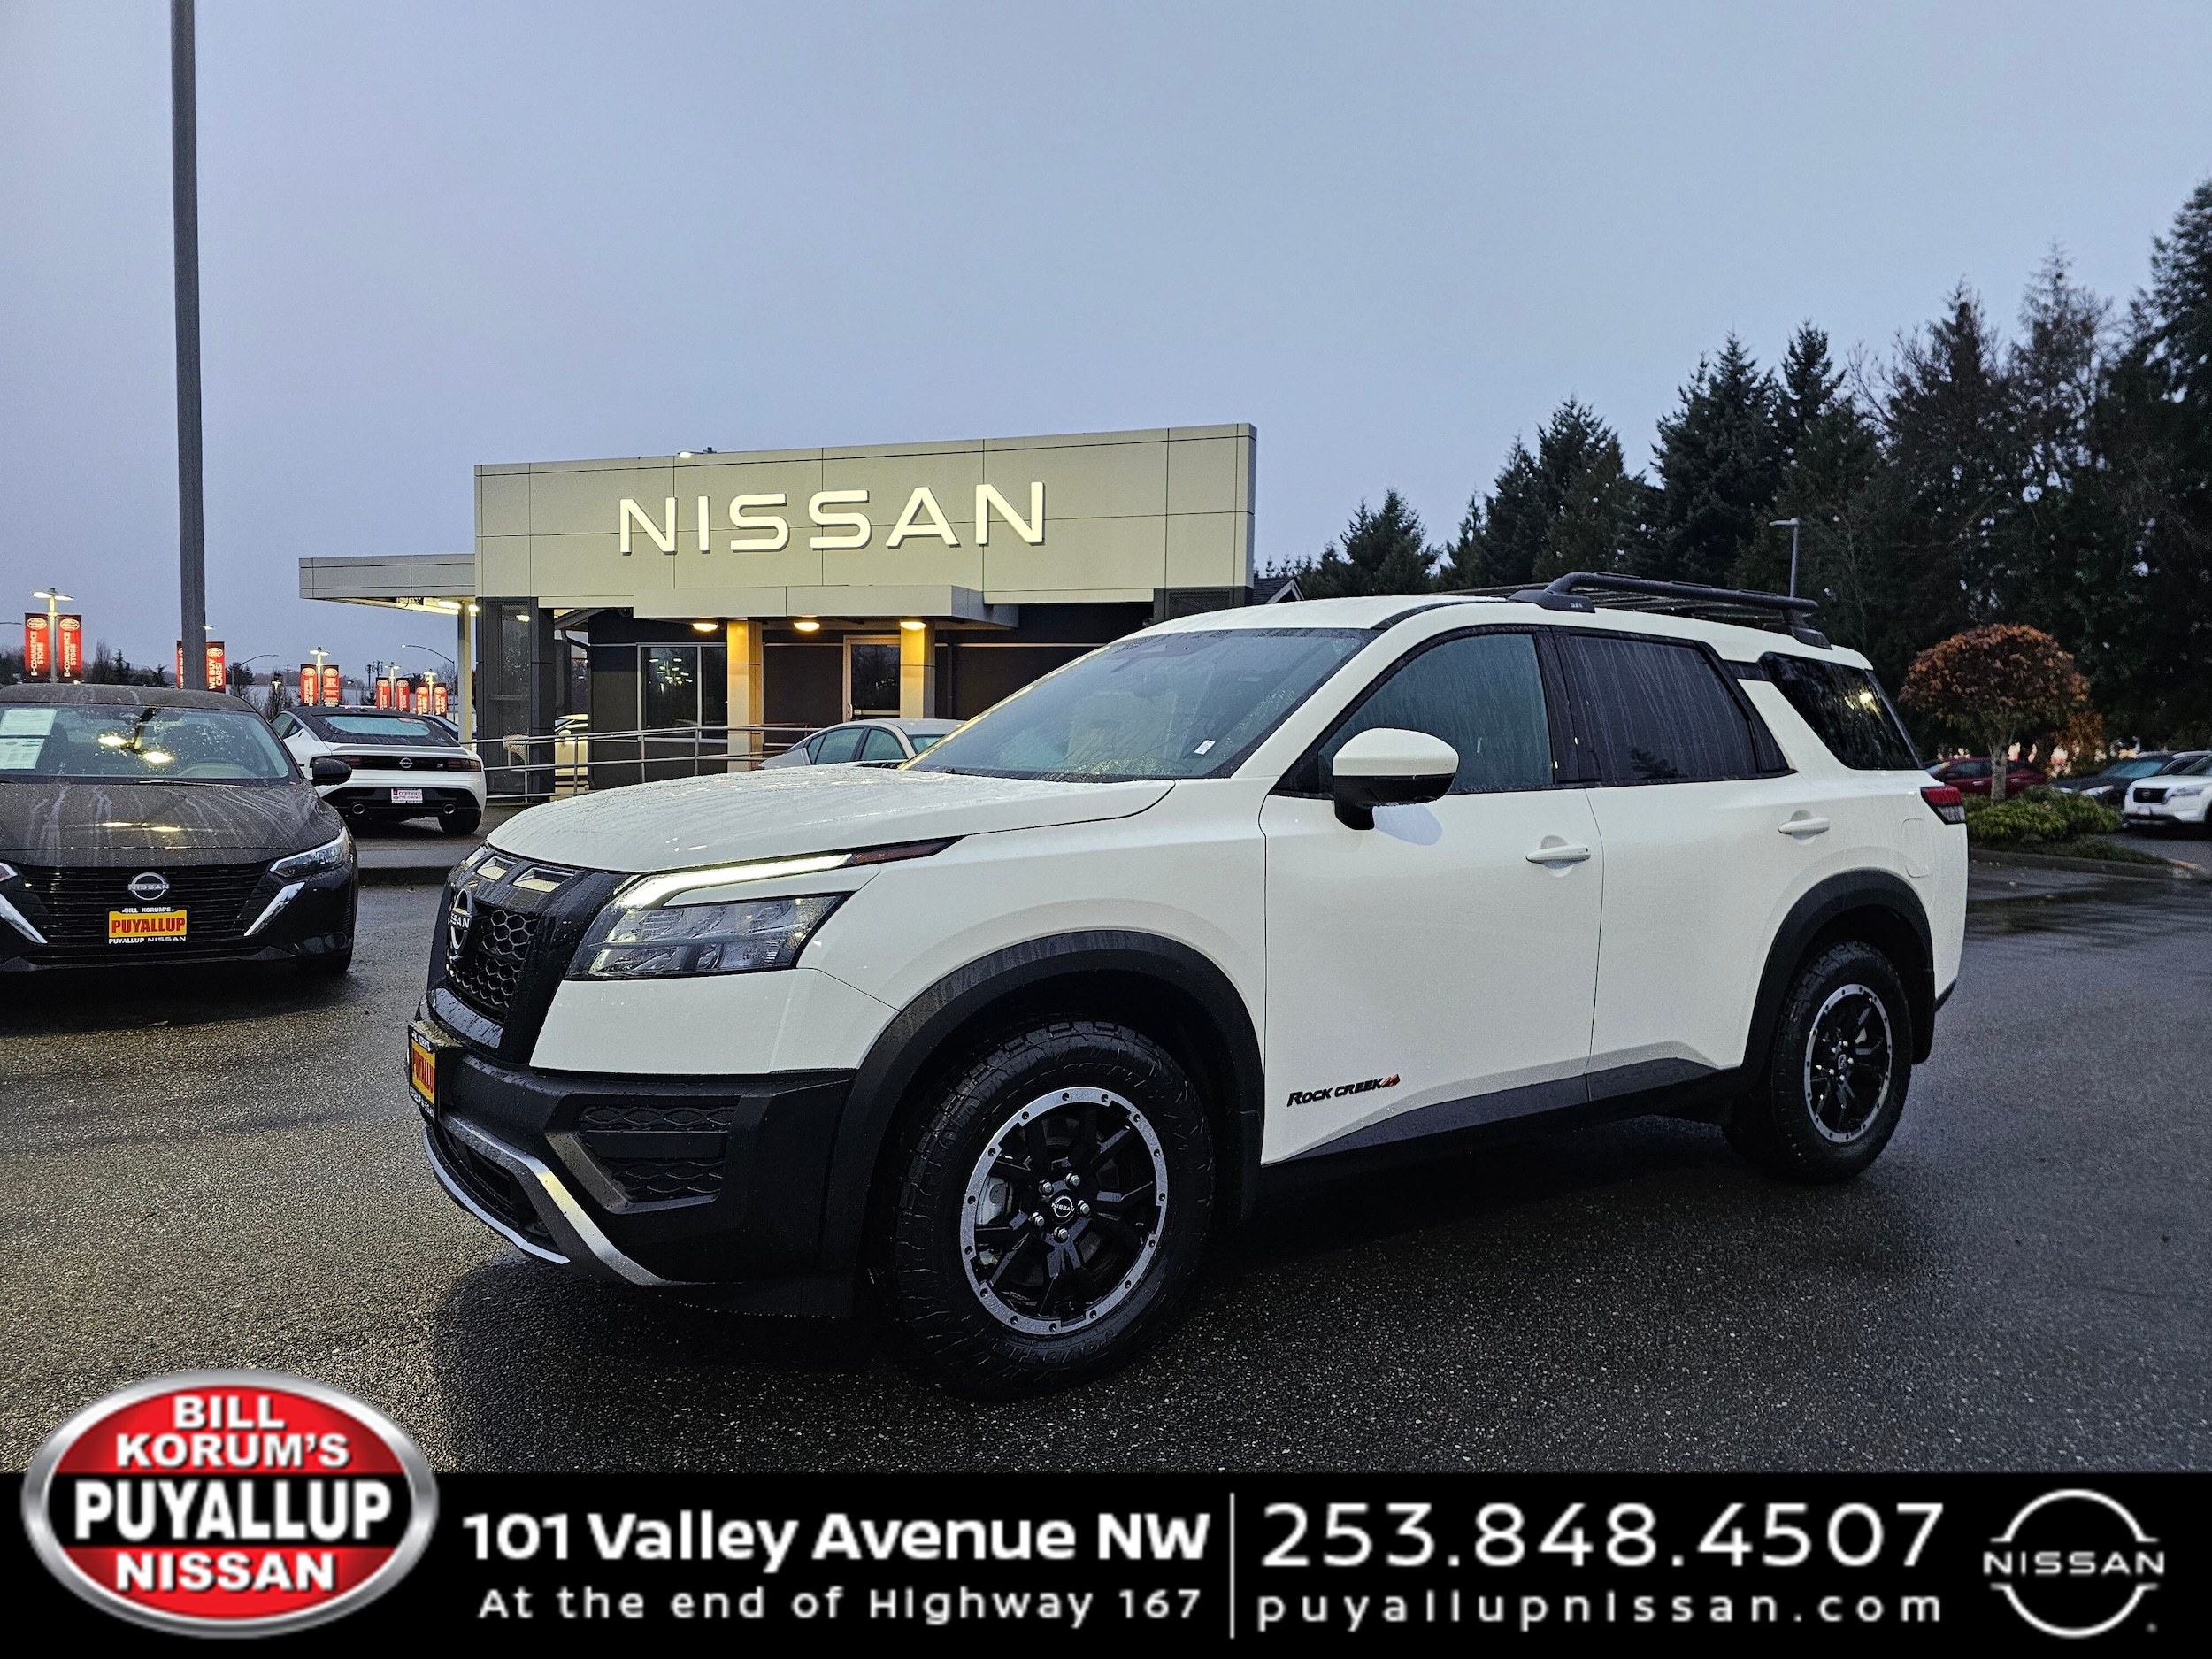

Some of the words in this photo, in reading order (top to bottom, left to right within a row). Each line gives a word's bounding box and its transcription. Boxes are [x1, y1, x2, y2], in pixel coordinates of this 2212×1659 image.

[620, 481, 1045, 554] NISSAN
[209, 676, 216, 690] WE
[111, 918, 185, 933] PUYALLUP
[1286, 1087, 1333, 1108] ROCK
[1334, 1077, 1384, 1098] CREEK
[1051, 1202, 1075, 1212] NISSAN
